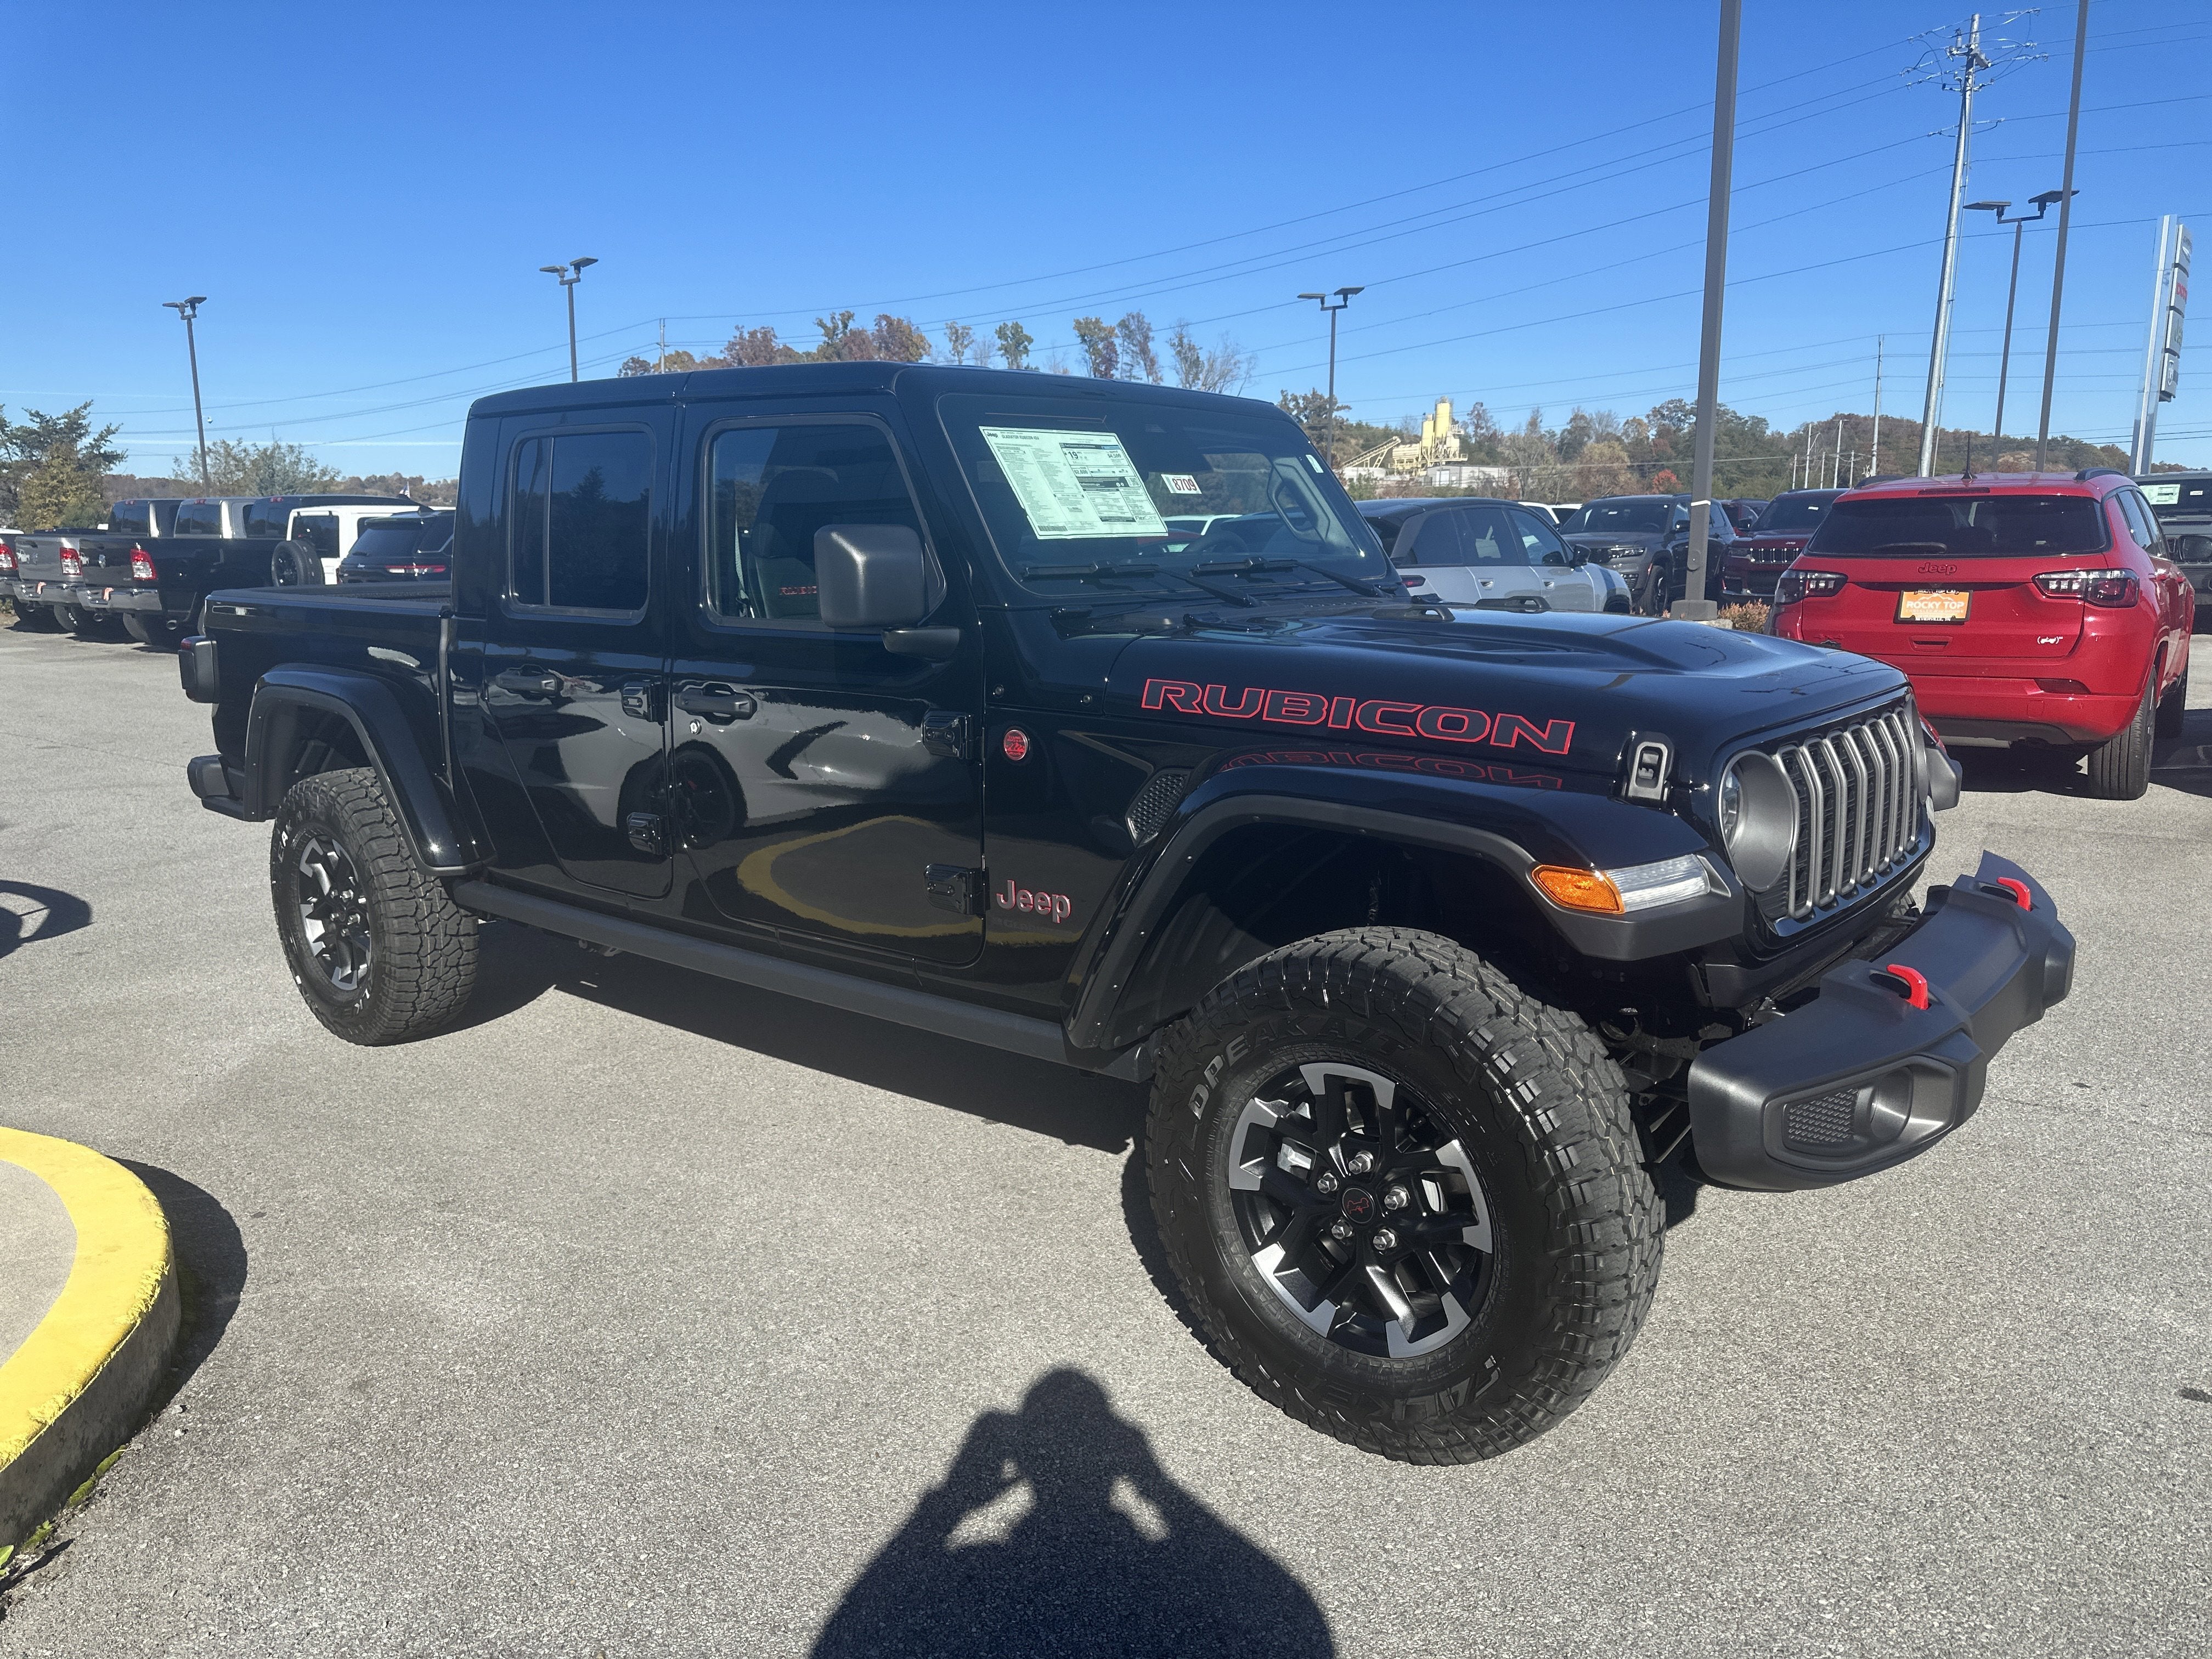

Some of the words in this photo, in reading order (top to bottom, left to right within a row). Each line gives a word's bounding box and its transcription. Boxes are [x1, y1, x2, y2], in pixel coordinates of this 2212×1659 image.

[1068, 451, 1079, 459] 19
[1172, 478, 1197, 491] 8709
[1917, 562, 1957, 575] Jeep
[1906, 601, 1940, 609] ROCKY
[1944, 601, 1965, 610] TOP
[1141, 678, 1576, 754] RUBICON
[996, 879, 1071, 924] Jeep
